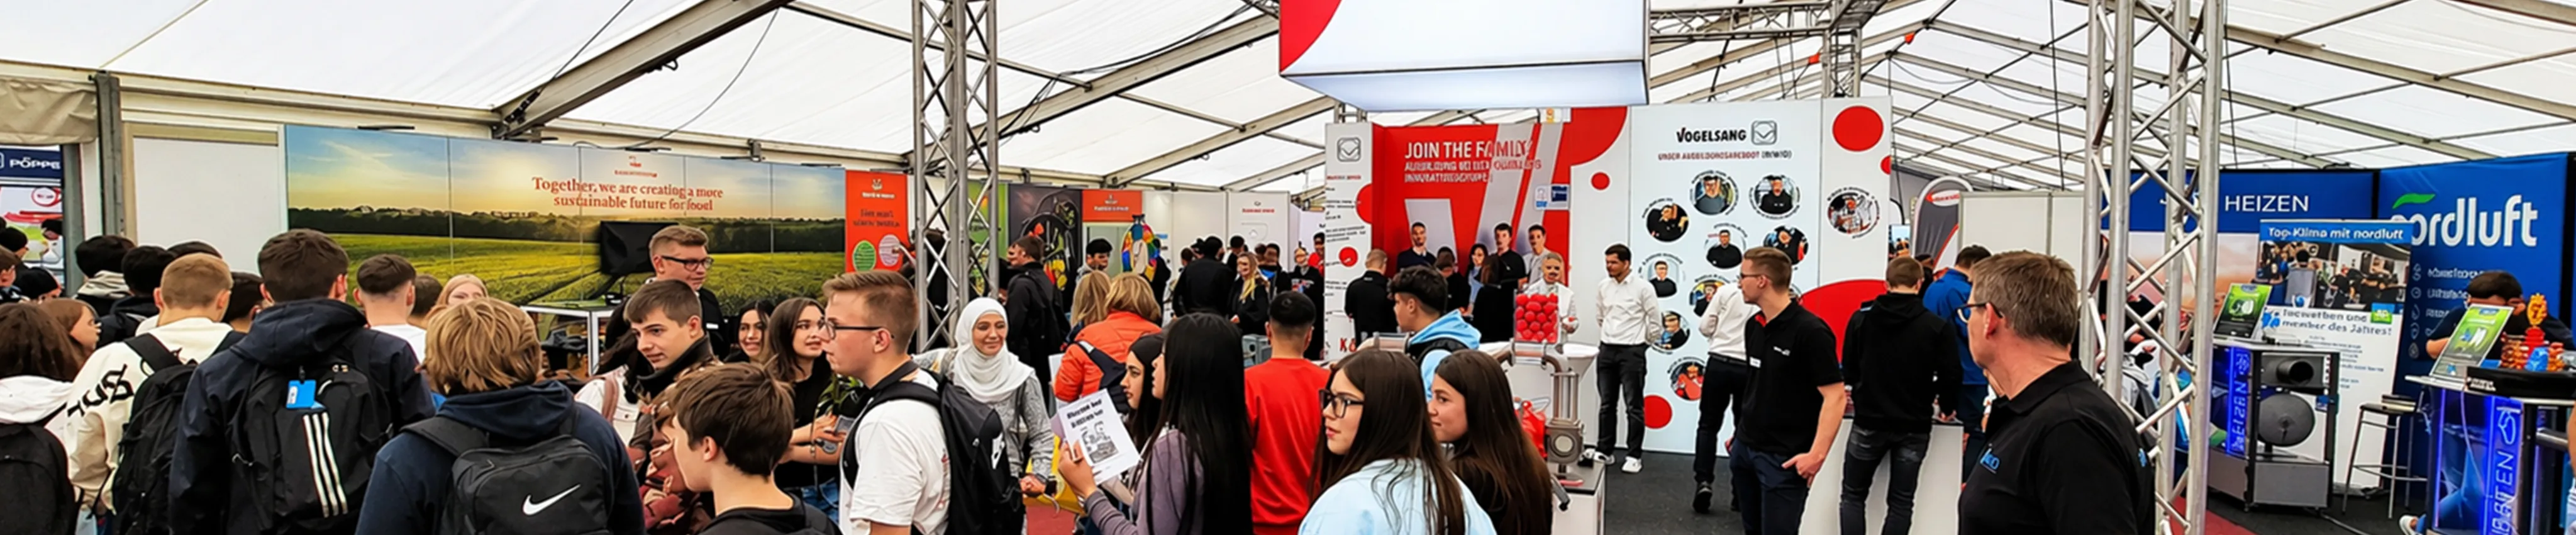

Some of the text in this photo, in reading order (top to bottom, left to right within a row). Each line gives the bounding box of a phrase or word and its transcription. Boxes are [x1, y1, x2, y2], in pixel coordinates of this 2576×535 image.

[1676, 127, 1746, 142] VOGELSANG
[1404, 142, 1440, 159] JOIN
[1443, 141, 1472, 158] THE
[599, 183, 617, 193] we
[619, 184, 638, 194] are
[640, 184, 686, 200] creating
[553, 194, 628, 208] sustainable
[630, 197, 667, 210] future
[2224, 195, 2309, 212] HEIZEN
[2391, 194, 2538, 247] ordluft
[2329, 228, 2350, 239] mit
[2353, 228, 2404, 240] nordluft
[2328, 322, 2347, 332] des
